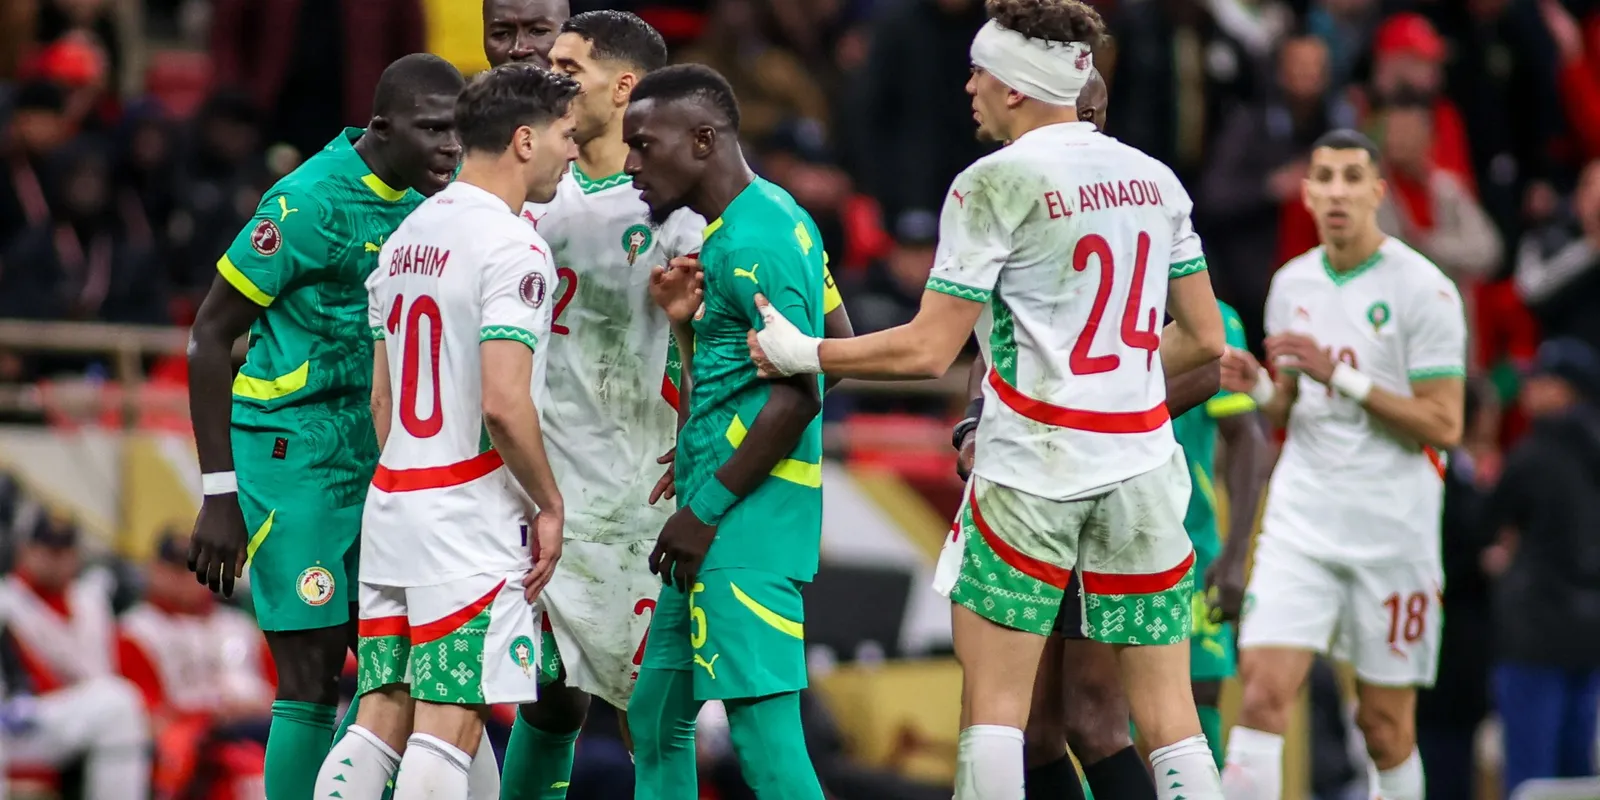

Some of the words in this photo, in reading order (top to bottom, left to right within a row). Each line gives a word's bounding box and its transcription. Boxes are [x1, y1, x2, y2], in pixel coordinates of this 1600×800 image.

[1044, 190, 1073, 220] EL
[1078, 179, 1163, 213] AYNAOUI
[389, 244, 451, 278] BRAHIM
[550, 268, 578, 335] 2
[1069, 230, 1160, 375] 24
[387, 293, 443, 438] 10
[689, 582, 707, 649] 5
[1382, 591, 1429, 643] 18
